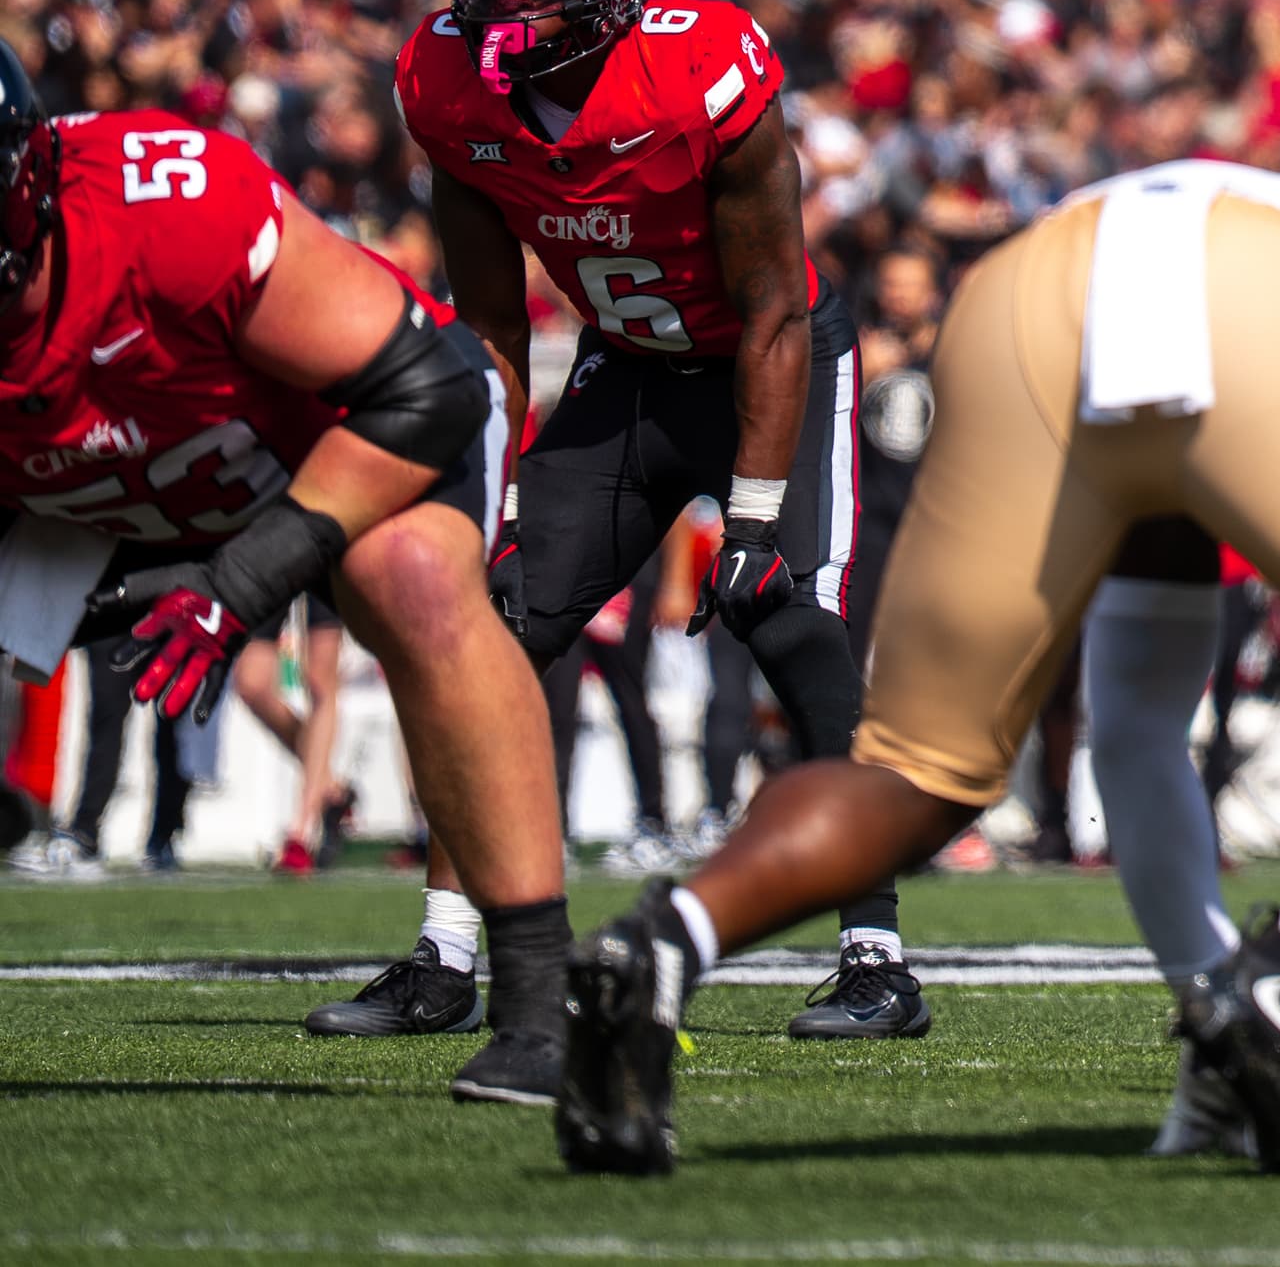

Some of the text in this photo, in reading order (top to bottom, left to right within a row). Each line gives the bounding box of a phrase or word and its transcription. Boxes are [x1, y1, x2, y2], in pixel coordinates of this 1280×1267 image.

[640, 7, 700, 34] 6
[122, 129, 207, 204] 53
[537, 205, 634, 250] CINCY
[575, 255, 695, 353] 6
[20, 418, 291, 541] 53
